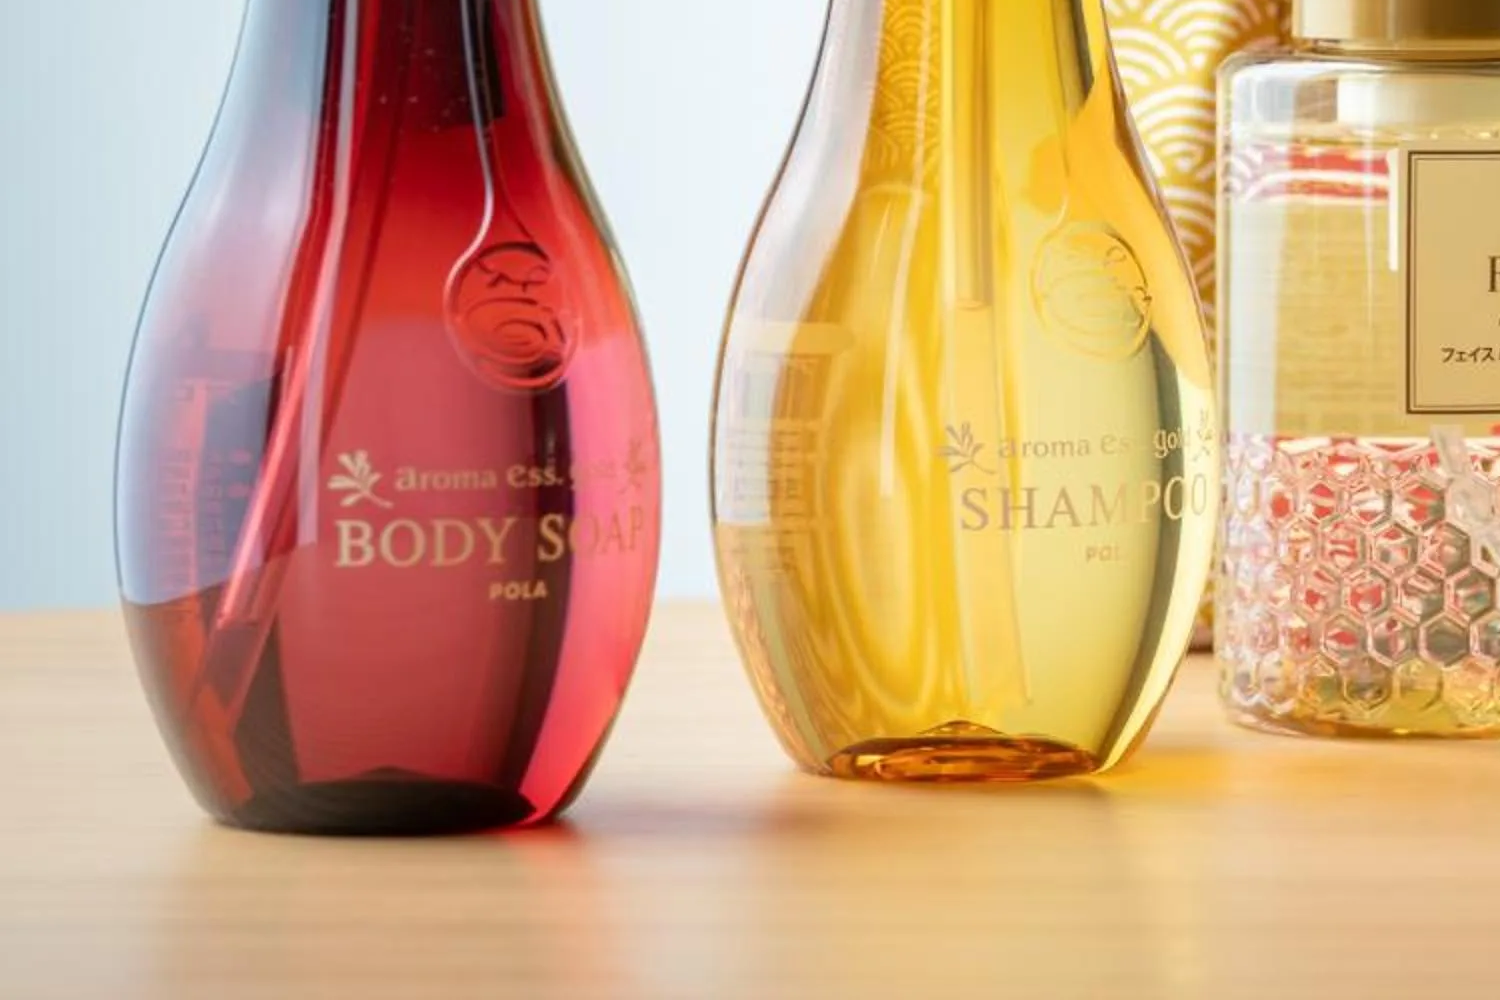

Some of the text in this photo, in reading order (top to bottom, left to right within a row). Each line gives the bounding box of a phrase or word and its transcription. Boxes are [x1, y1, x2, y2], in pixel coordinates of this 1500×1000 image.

[999, 436, 1090, 460] aroma
[394, 465, 497, 492] aroma
[960, 472, 1208, 533] SHAMPOO
[334, 504, 646, 569] BODY SOAP
[1086, 545, 1127, 563] POL
[488, 581, 548, 600] POLA
